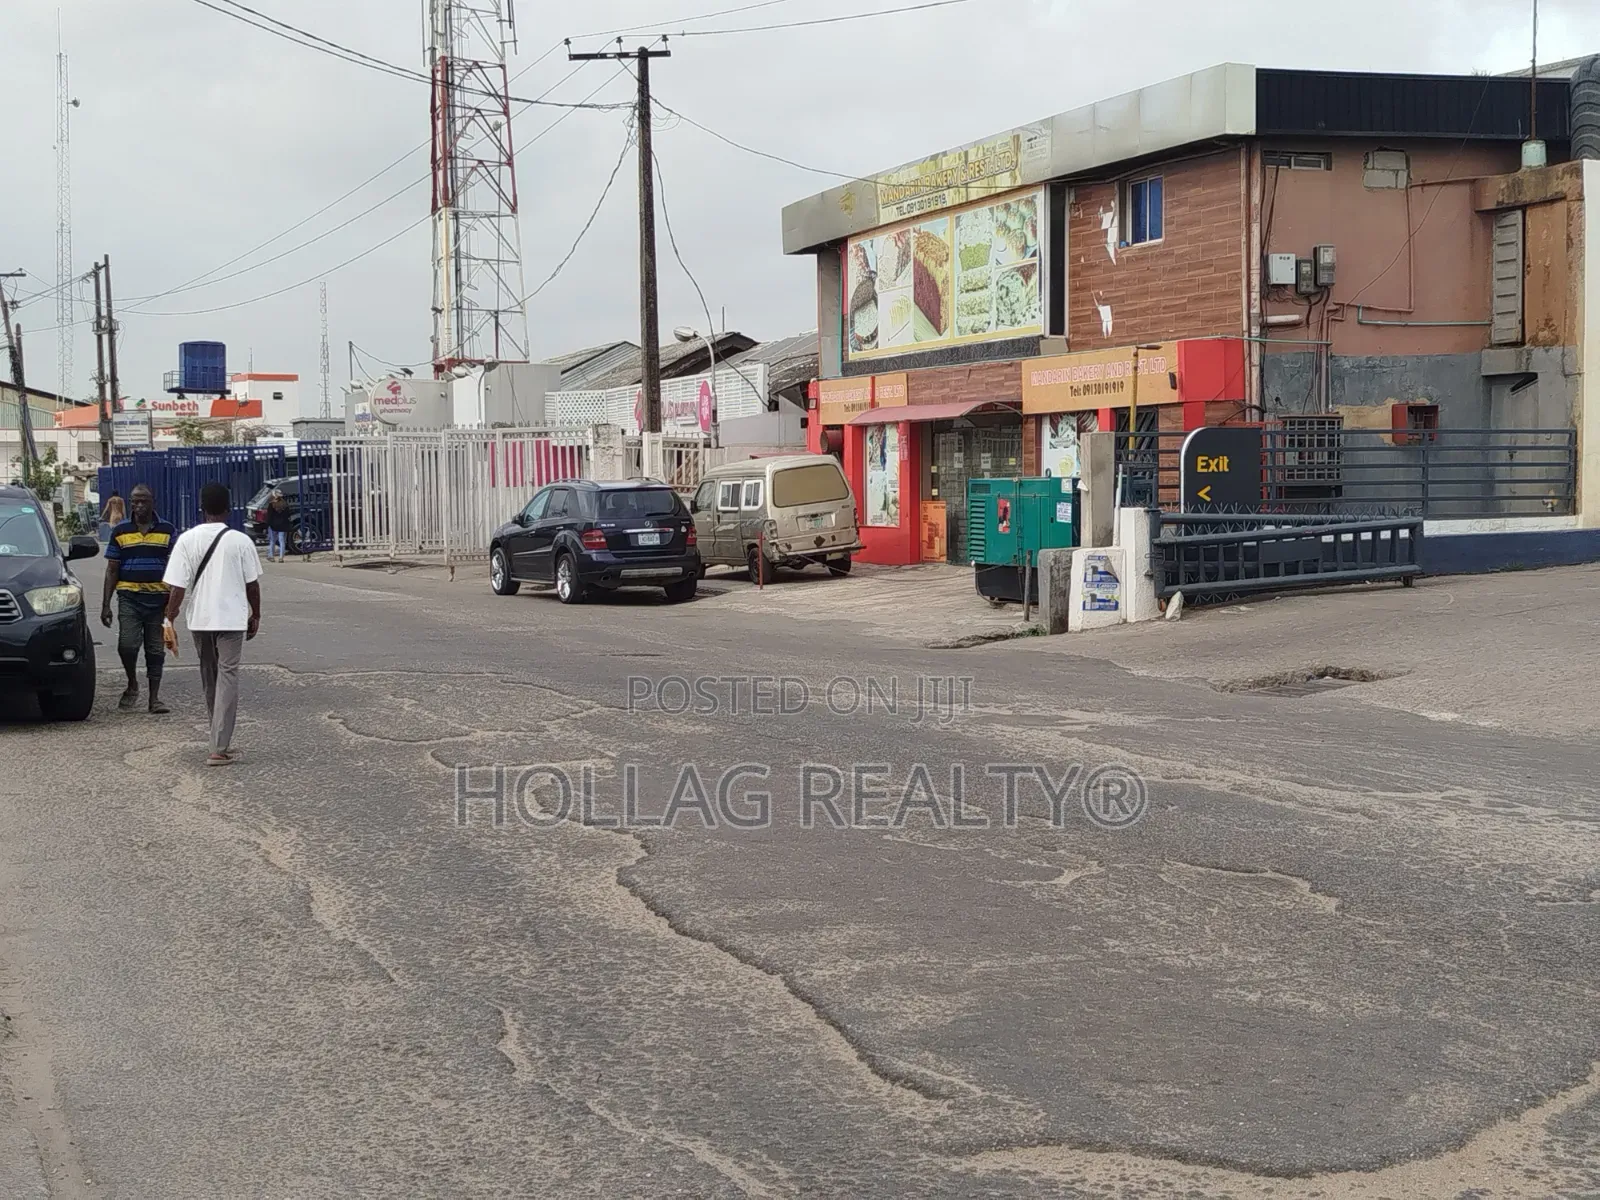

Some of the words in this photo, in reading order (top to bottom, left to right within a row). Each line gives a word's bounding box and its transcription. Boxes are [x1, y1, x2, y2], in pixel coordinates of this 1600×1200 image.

[880, 177, 924, 206] MANDARIN
[924, 166, 959, 192] BAKERY
[1031, 367, 1070, 386] MANDARIN
[1071, 364, 1104, 382] BAKERY
[1106, 361, 1125, 379] AND
[1125, 358, 1149, 376] RST.
[1150, 356, 1167, 373] LTD
[151, 400, 199, 411] Sunbeth
[374, 395, 418, 407] medplus
[380, 407, 413, 415] pharmacy
[1196, 455, 1230, 473] Exit
